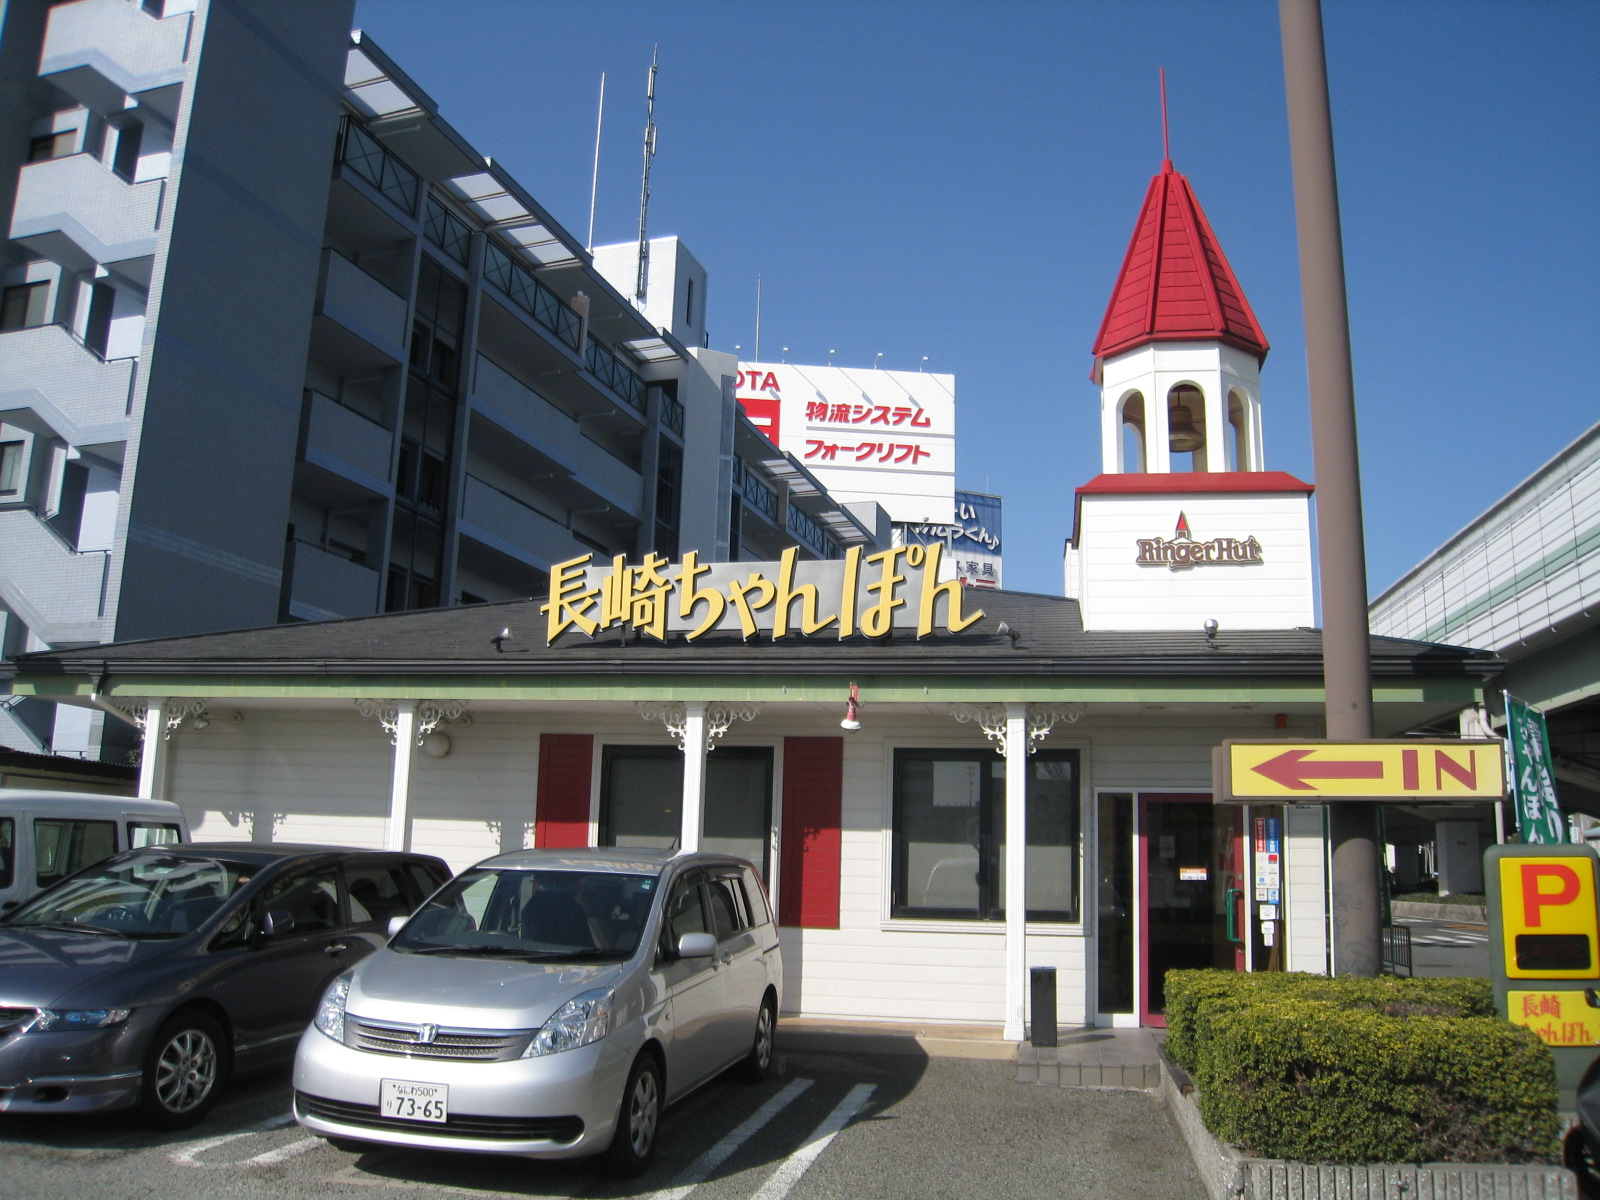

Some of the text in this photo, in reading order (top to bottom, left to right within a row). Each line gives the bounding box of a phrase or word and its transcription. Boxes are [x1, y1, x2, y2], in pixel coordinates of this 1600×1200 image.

[805, 401, 931, 427] 物流システム
[804, 439, 931, 465] フォークリフト
[540, 541, 985, 647] 長崎ちゃんぽん
[1402, 750, 1477, 790] IN
[1520, 864, 1581, 927] P
[1522, 994, 1561, 1018] 長崎
[1523, 1022, 1592, 1043] ゃんぽん
[396, 1097, 444, 1119] 73-65
